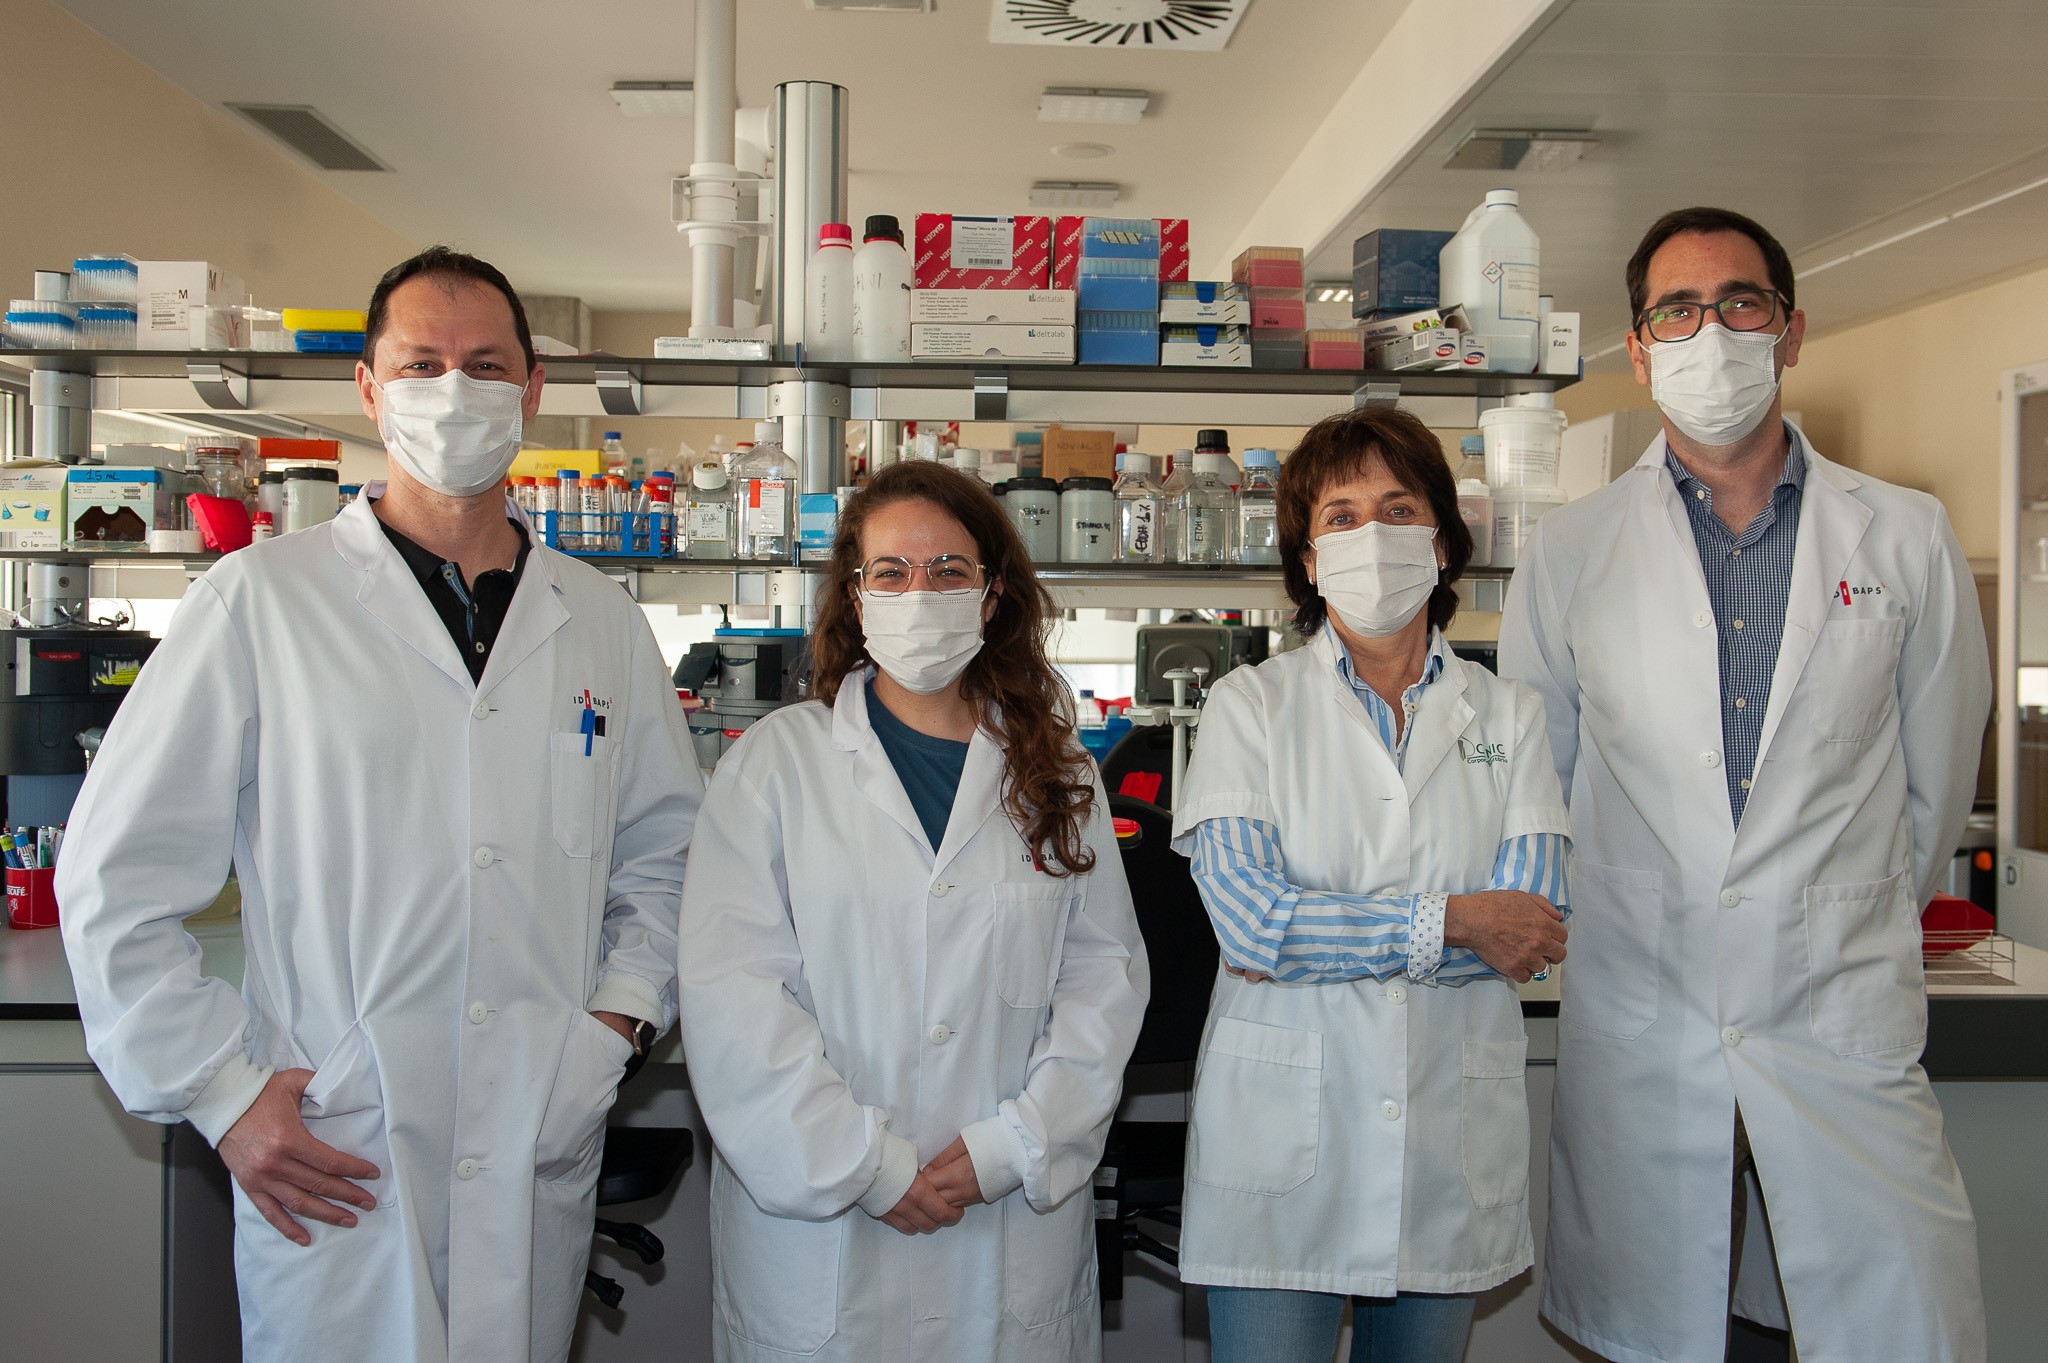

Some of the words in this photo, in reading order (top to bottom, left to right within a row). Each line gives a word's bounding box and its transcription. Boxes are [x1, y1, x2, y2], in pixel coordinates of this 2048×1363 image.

[923, 223, 945, 244] QIAGEN
[1012, 238, 1034, 259] QIAGEN
[929, 268, 950, 289] QIAGEN
[1001, 265, 1023, 286] QIAGEN
[179, 289, 188, 299] M
